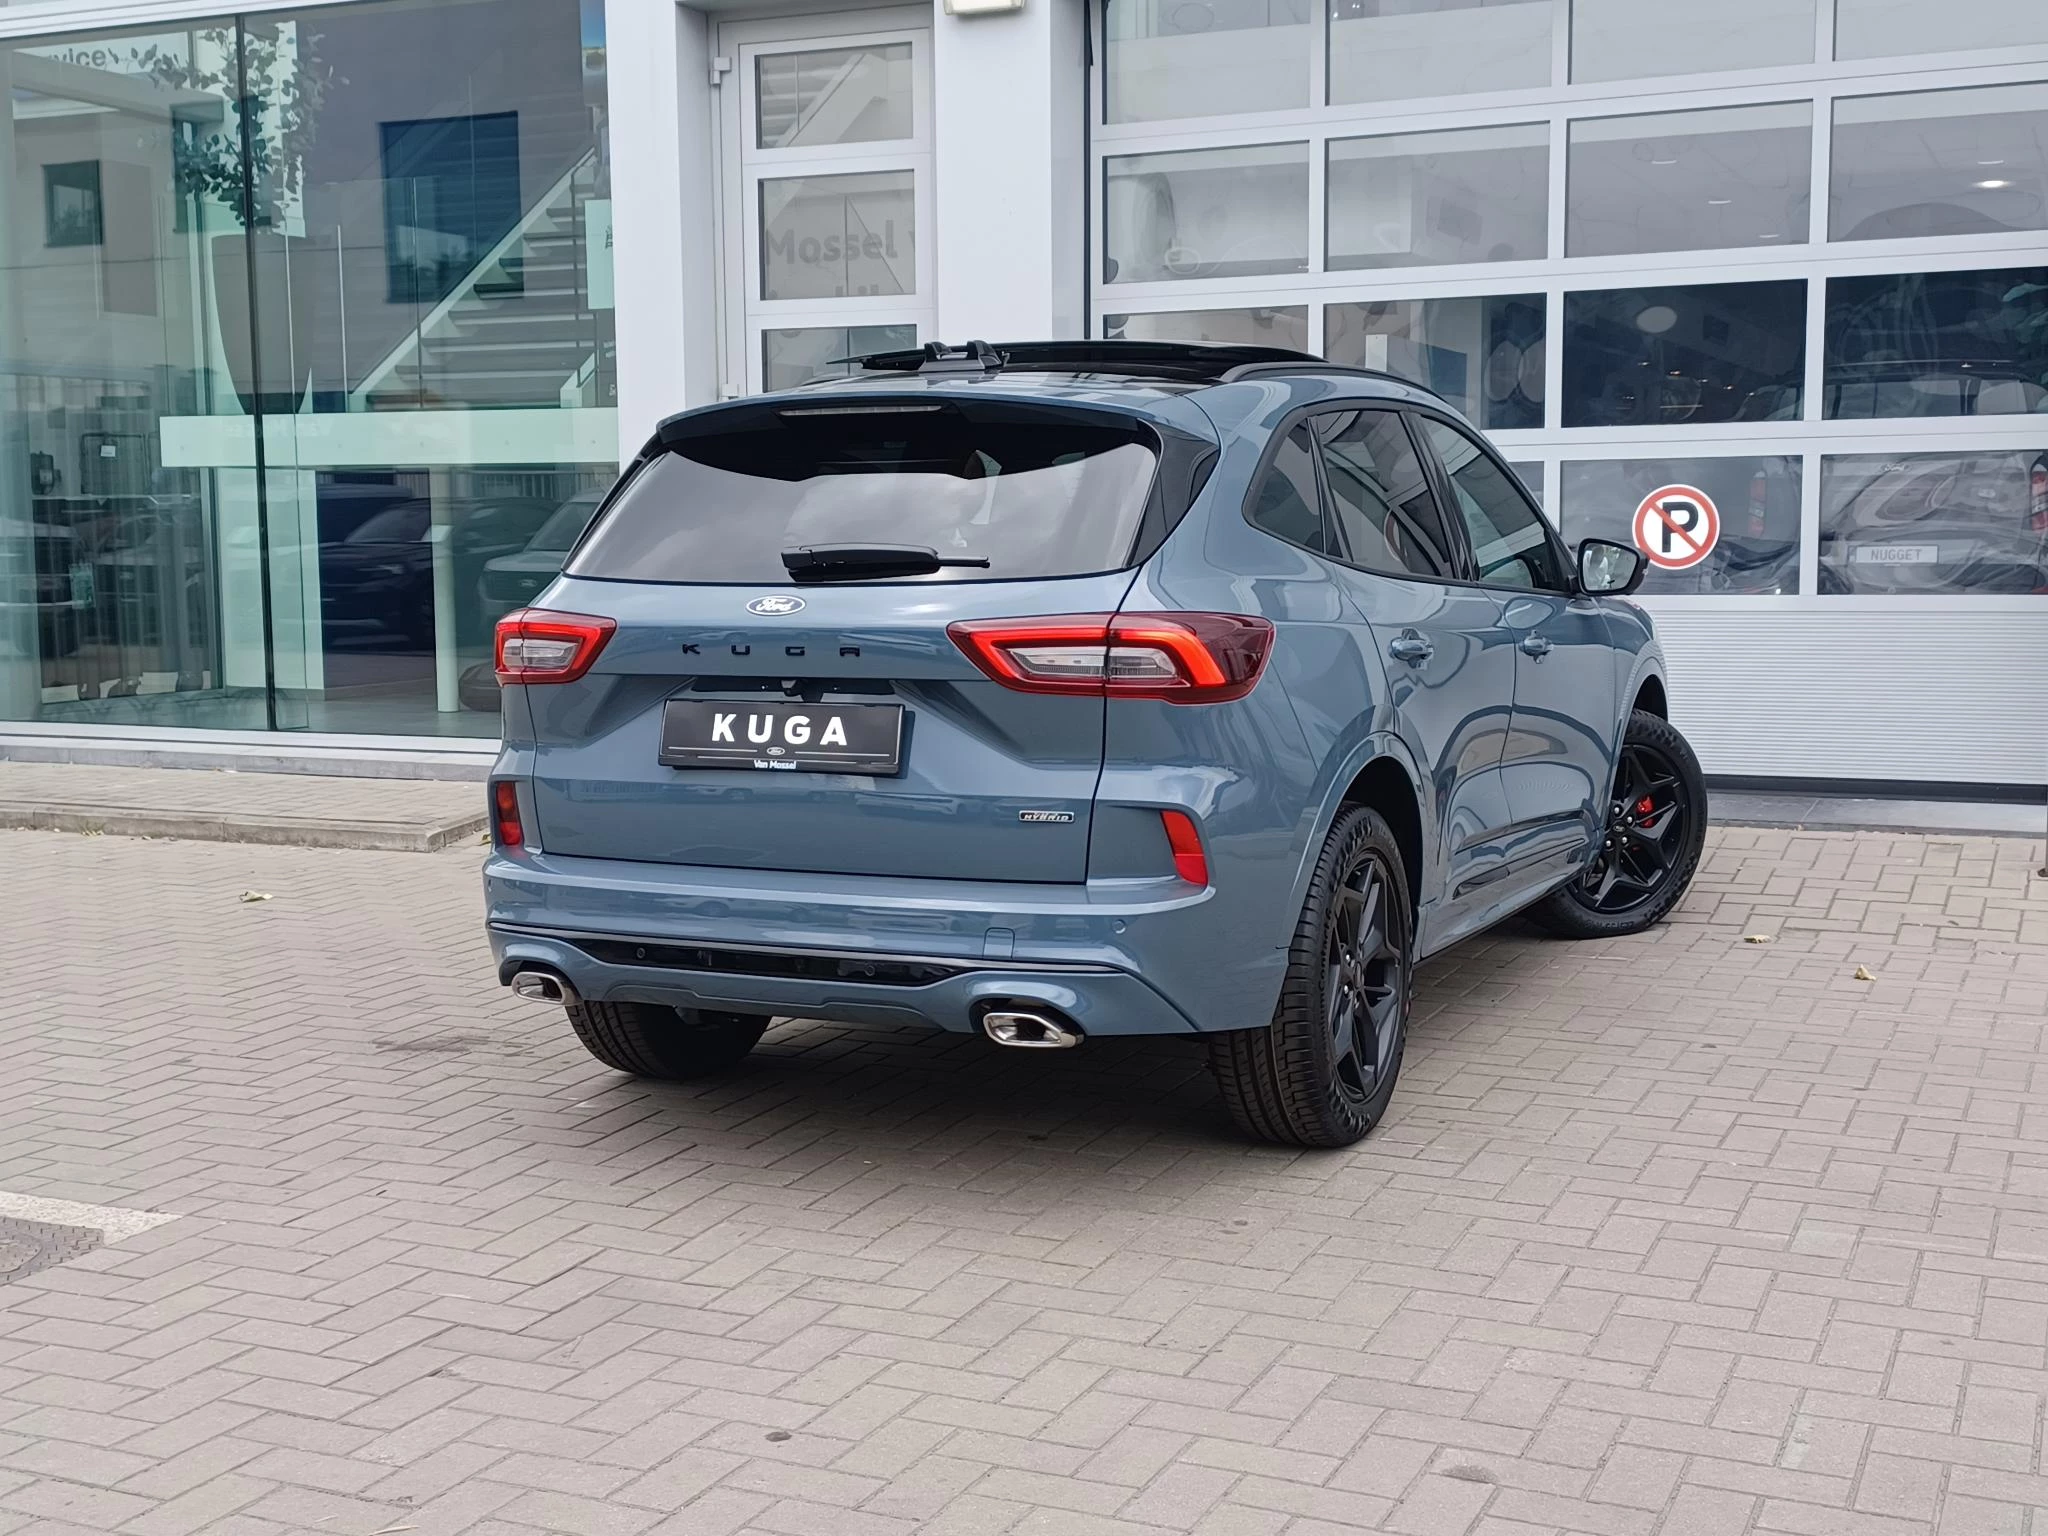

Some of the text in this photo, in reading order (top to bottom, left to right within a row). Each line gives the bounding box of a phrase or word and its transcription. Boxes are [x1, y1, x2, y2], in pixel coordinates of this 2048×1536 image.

[765, 219, 898, 265] Mossel
[1661, 501, 1699, 553] P
[1870, 548, 1923, 562] NUGGET
[755, 597, 795, 612] Ford
[682, 643, 860, 657] KUGA
[711, 713, 848, 746] KUGA
[753, 759, 797, 770] Van Mossel
